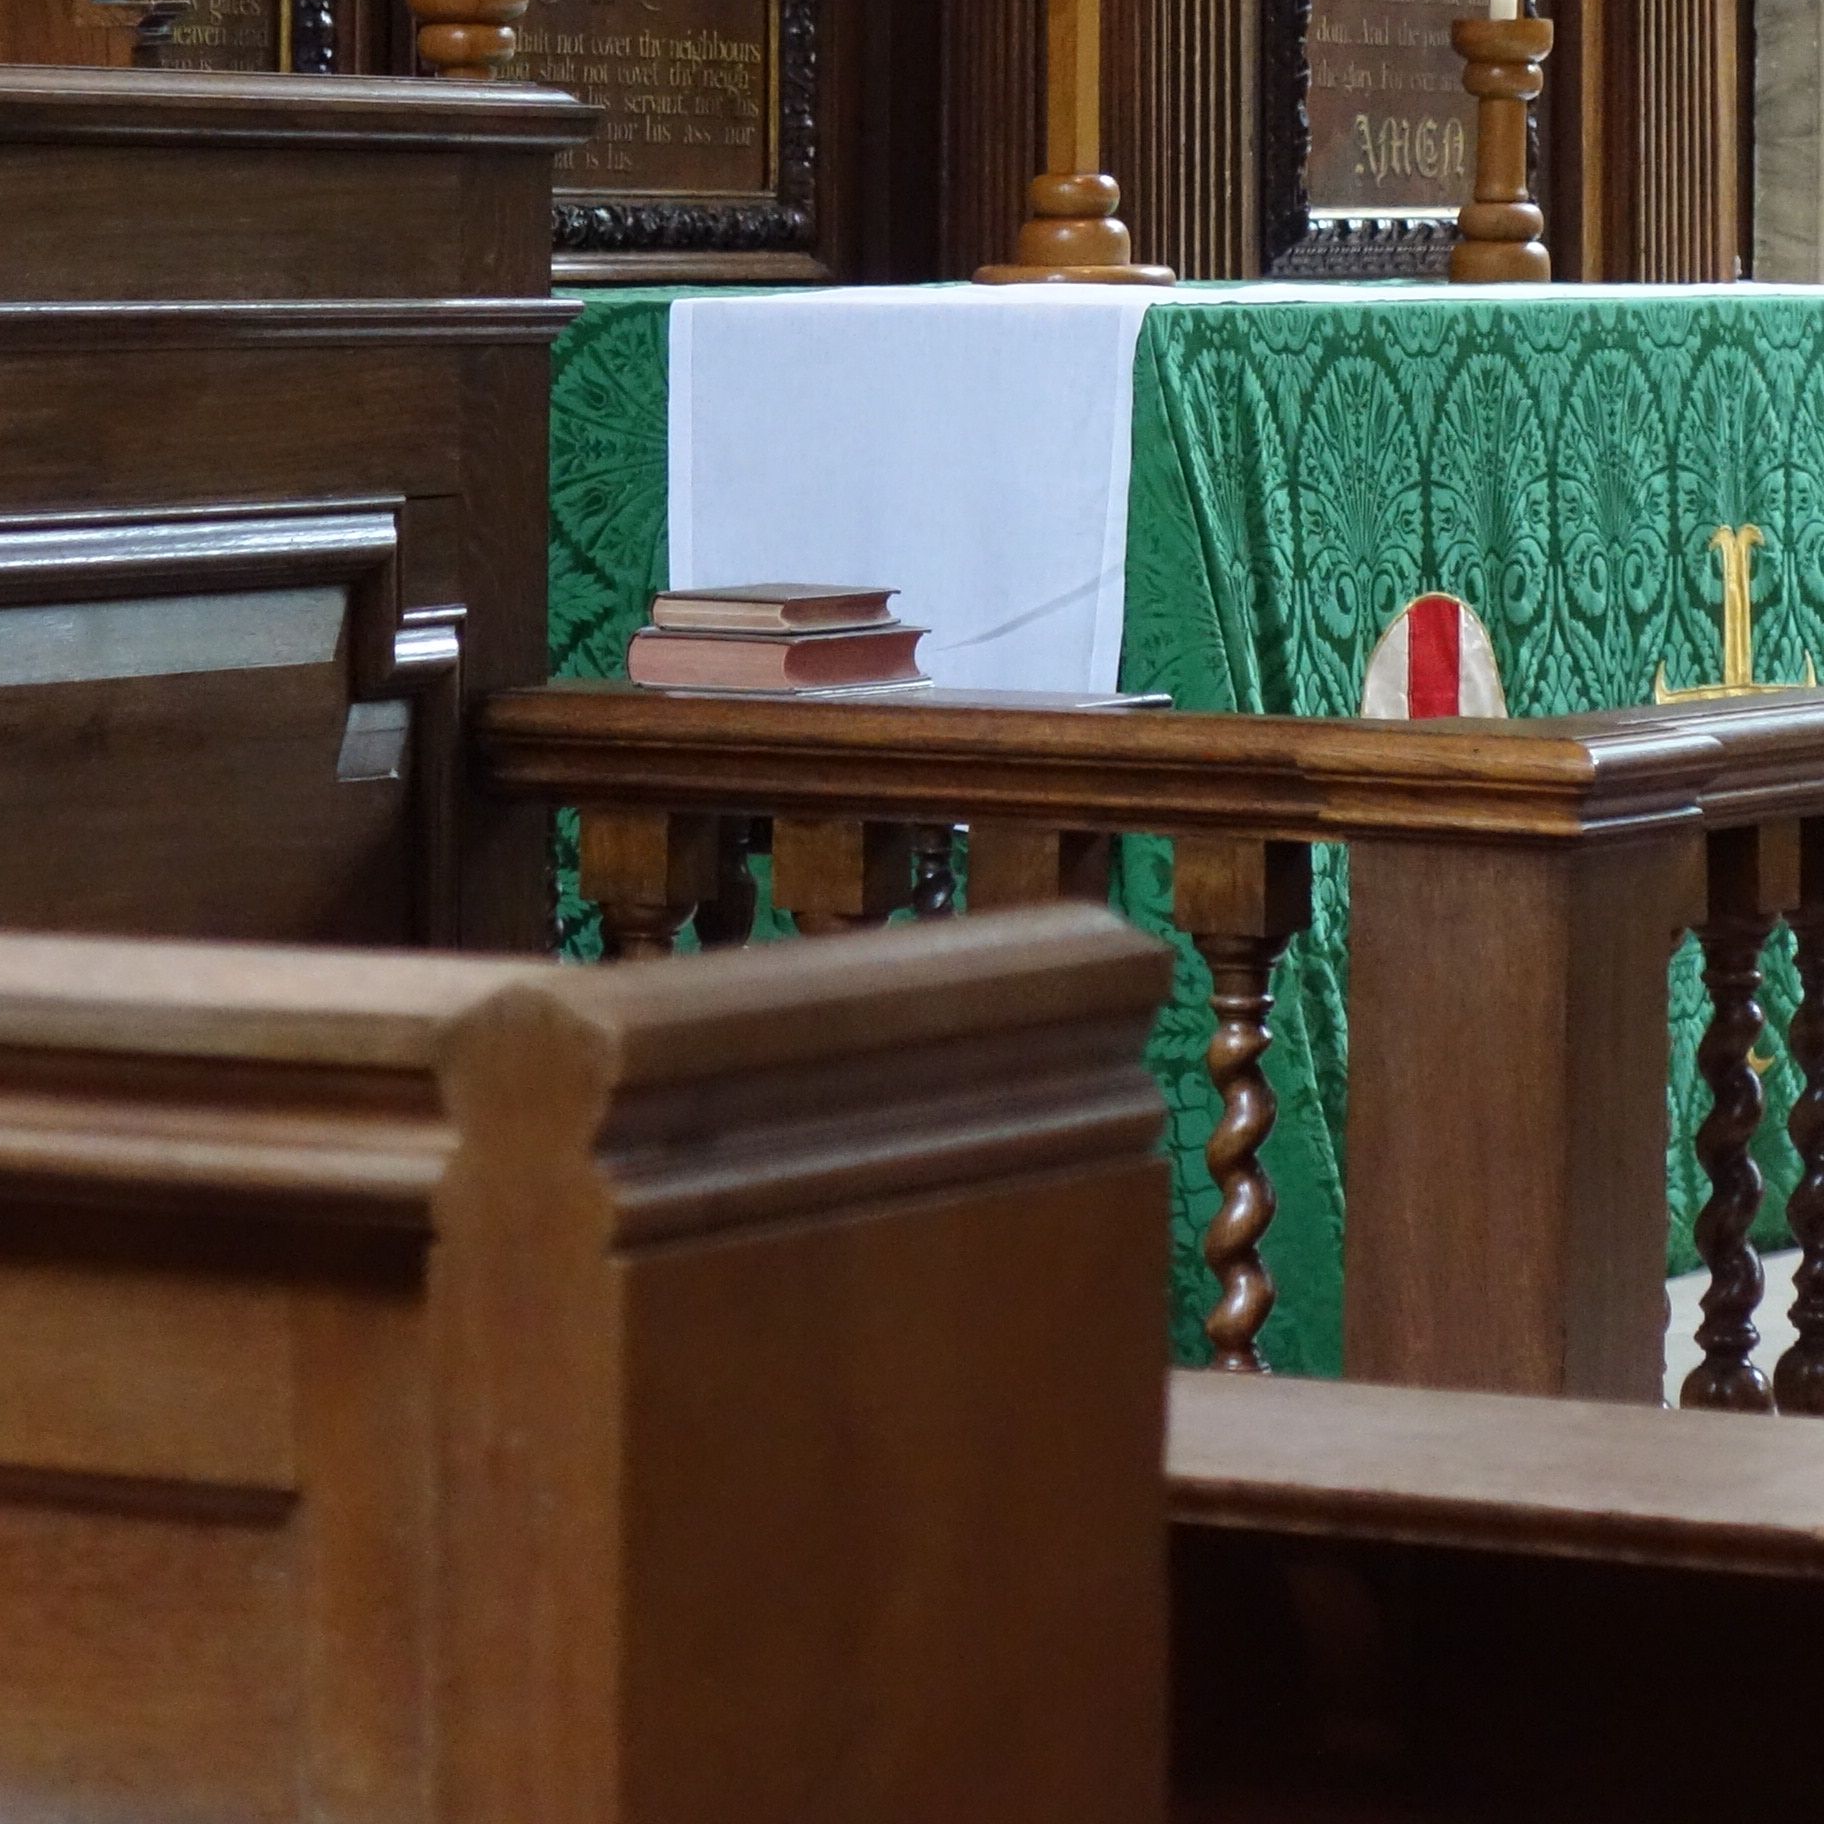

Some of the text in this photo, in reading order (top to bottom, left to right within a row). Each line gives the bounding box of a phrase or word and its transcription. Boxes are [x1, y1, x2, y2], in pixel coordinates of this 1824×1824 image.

[557, 33, 585, 55] not
[639, 28, 666, 59] thy
[669, 28, 762, 71] neighbours
[540, 55, 575, 84] shalt
[583, 63, 609, 84] not
[617, 62, 659, 86] covet
[607, 114, 756, 147] nor his ass nor
